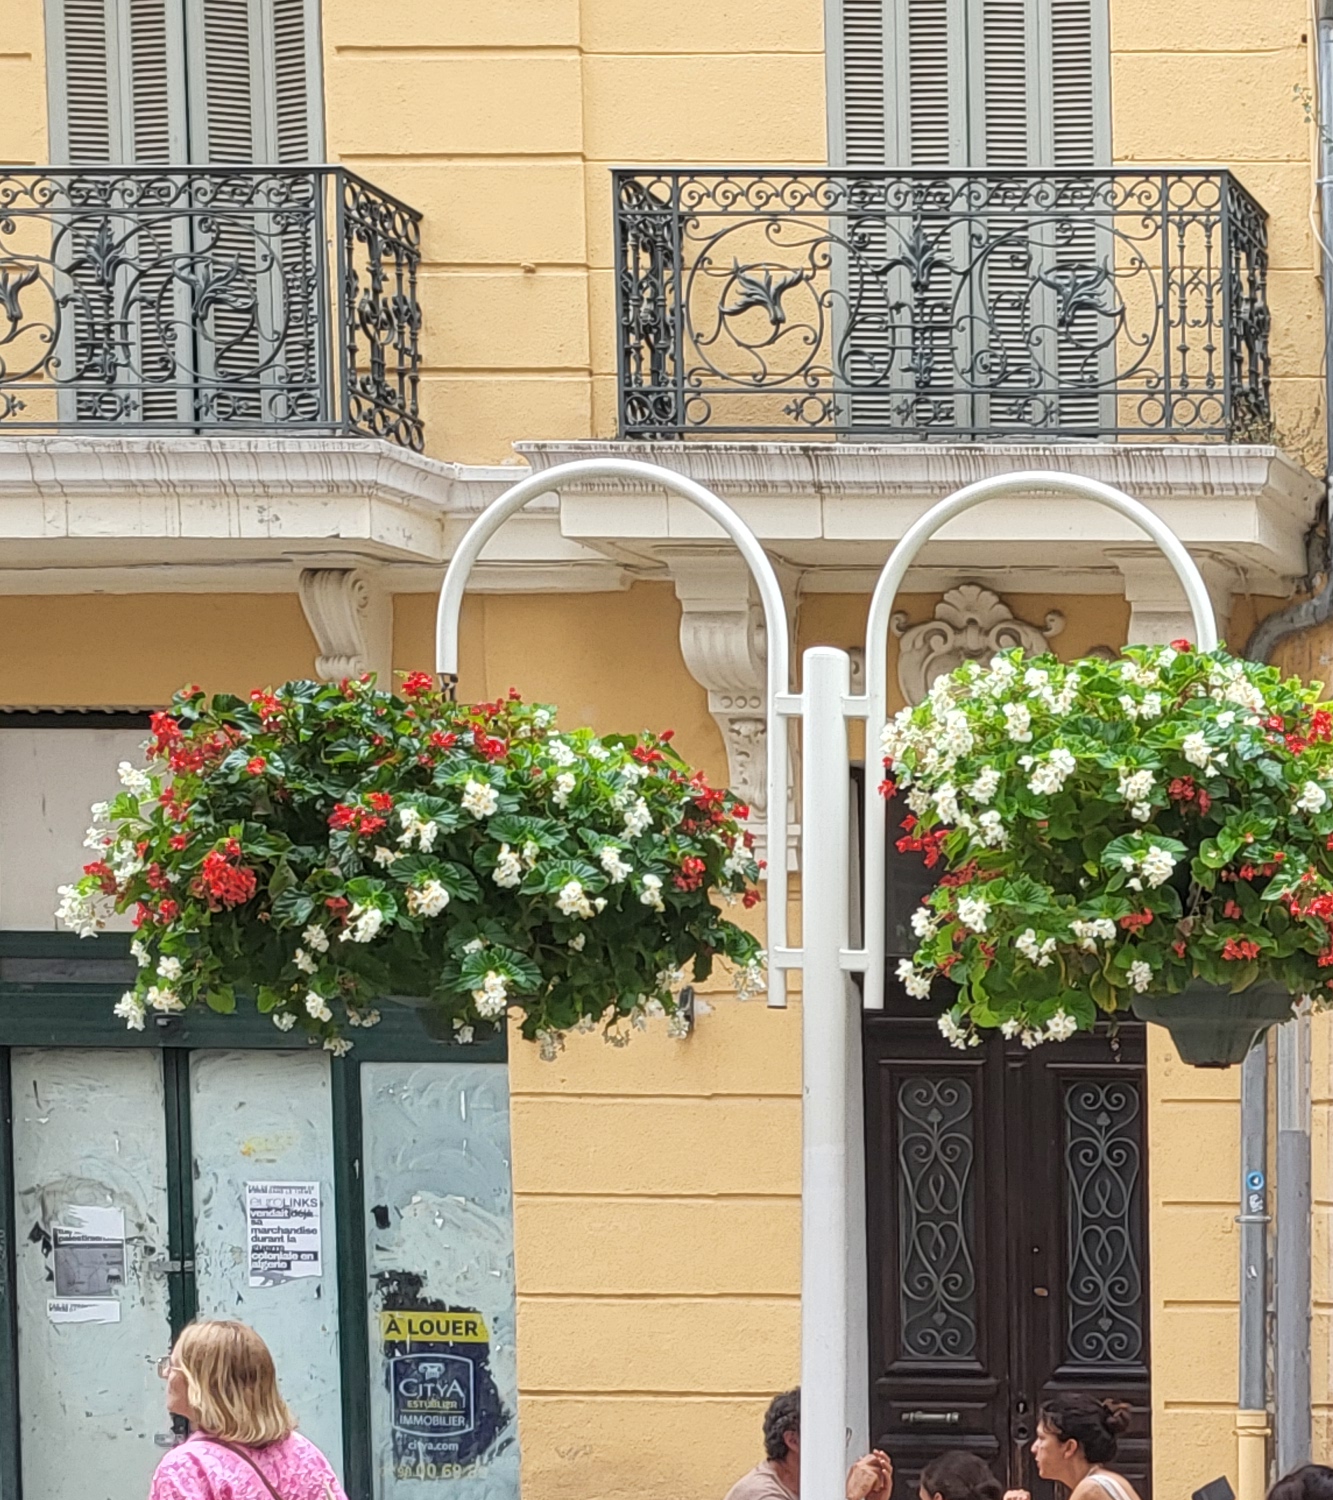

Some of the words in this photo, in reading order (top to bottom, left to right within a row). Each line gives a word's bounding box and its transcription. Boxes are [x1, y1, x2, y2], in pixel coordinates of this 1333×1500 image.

[385, 1314, 402, 1335] À
[408, 1319, 479, 1337] LOUER
[400, 1415, 466, 1427] IMMOBILIER
